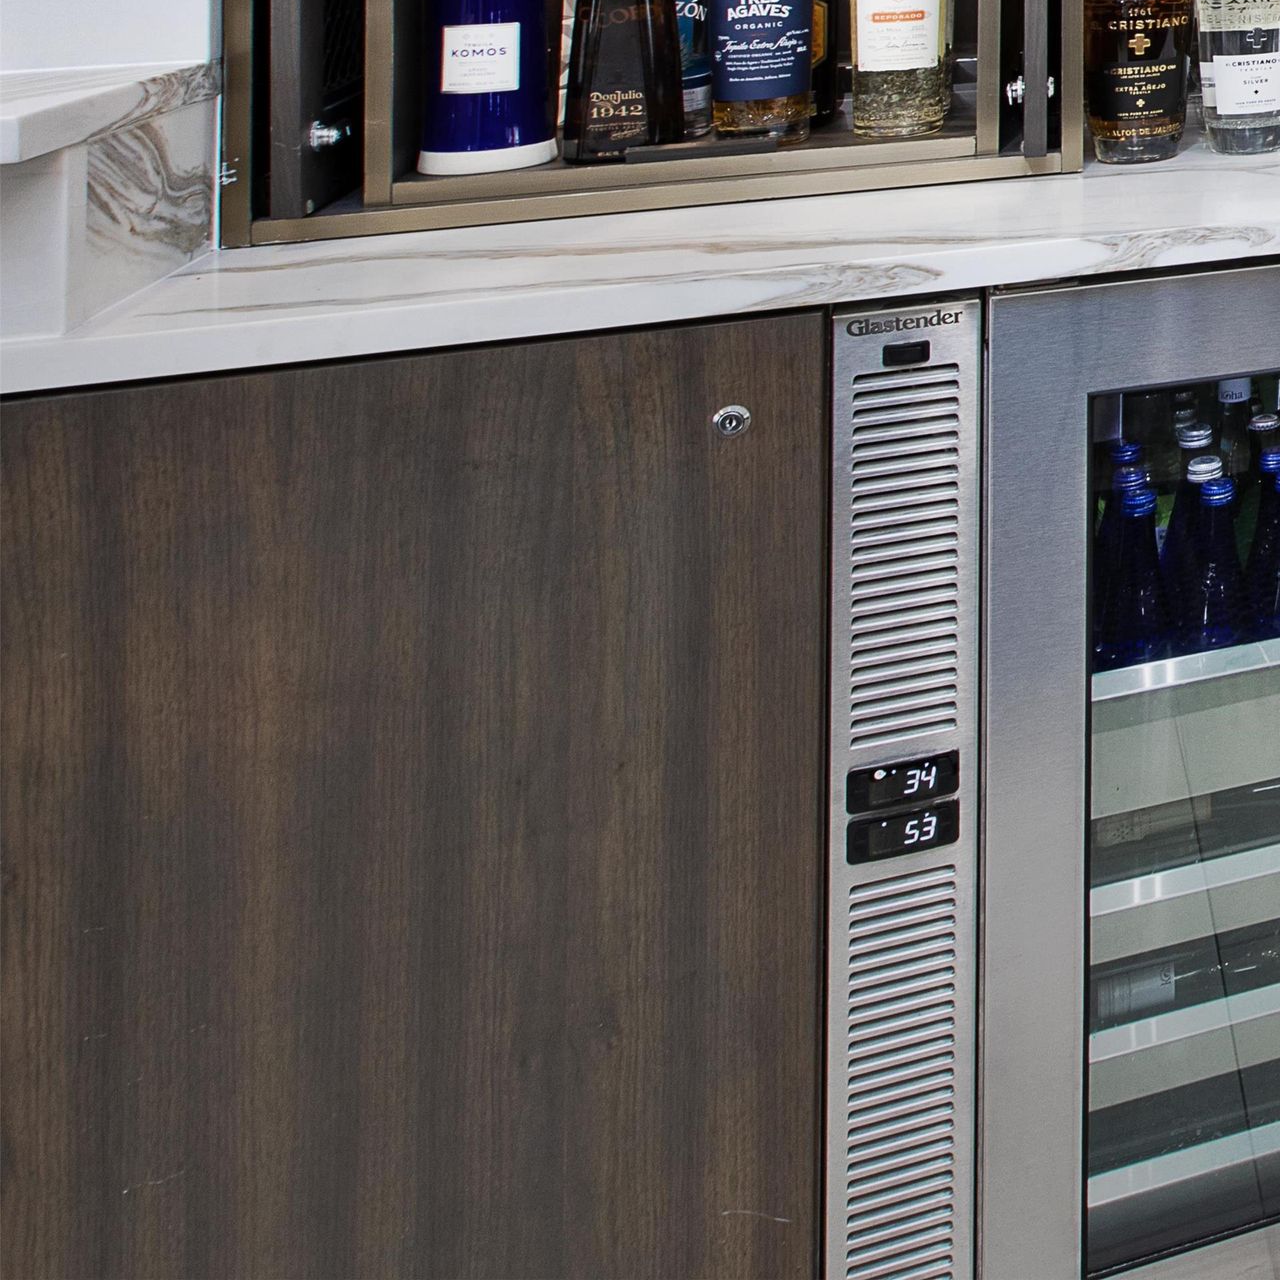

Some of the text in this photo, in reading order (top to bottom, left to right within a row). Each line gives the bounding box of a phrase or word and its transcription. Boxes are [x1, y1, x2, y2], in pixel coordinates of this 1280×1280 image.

[727, 4, 793, 21] AGAVES
[873, 11, 923, 21] REPOSADO
[734, 21, 784, 30] ORGANIC
[1108, 15, 1189, 30] CRISTIANO
[749, 38, 773, 50] Extra
[451, 47, 507, 58] KOMOS
[1232, 58, 1277, 67] CRISTIANO
[1109, 64, 1167, 76] CRISTIANO
[611, 90, 643, 104] Julio
[591, 105, 643, 119] 1942
[846, 309, 963, 337] Glastender
[904, 766, 937, 794] 34
[904, 816, 937, 845] 53
